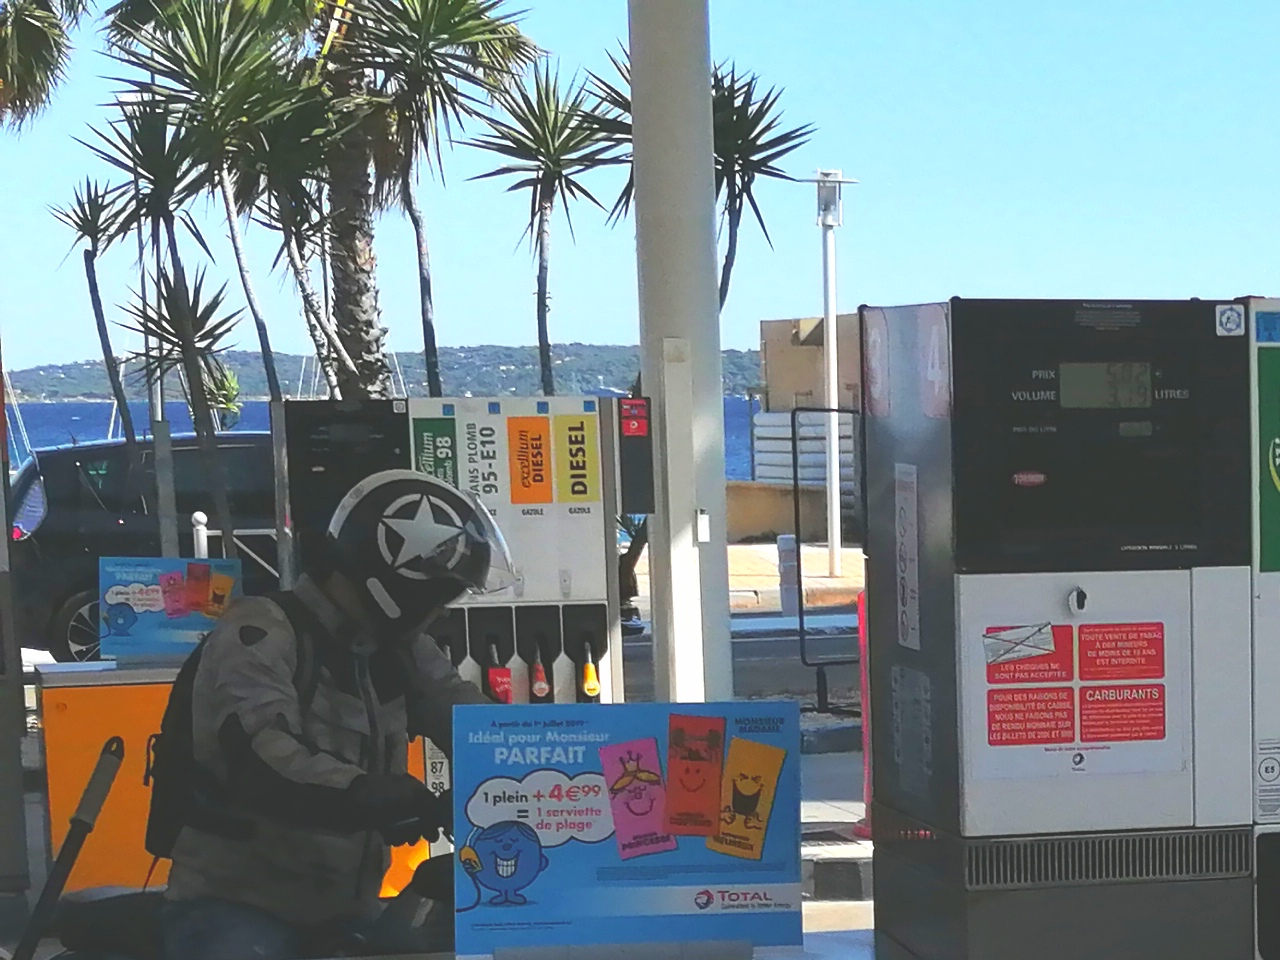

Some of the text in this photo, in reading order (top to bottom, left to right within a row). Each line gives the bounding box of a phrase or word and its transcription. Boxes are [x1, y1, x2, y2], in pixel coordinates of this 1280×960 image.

[1032, 370, 1055, 379] PRIX
[1011, 390, 1057, 401] VOLUME
[1155, 389, 1190, 399] LITRES
[436, 437, 452, 458] 98
[466, 423, 478, 464] PLOMB
[480, 426, 498, 495] 95-E10
[516, 430, 531, 488] excellium
[530, 434, 544, 483] DIESEL
[568, 421, 588, 496] DIESEL
[1086, 688, 1159, 702] CARBURANTS
[468, 730, 609, 746] Idéal pour Monsieur
[494, 745, 586, 765] PARFAIT
[430, 761, 444, 774] 87
[1264, 766, 1275, 774] E5
[483, 792, 489, 803] 1
[492, 790, 528, 806] plein
[546, 806, 602, 817] serviette
[536, 819, 593, 833] de plage
[717, 890, 773, 902] TOTAL
